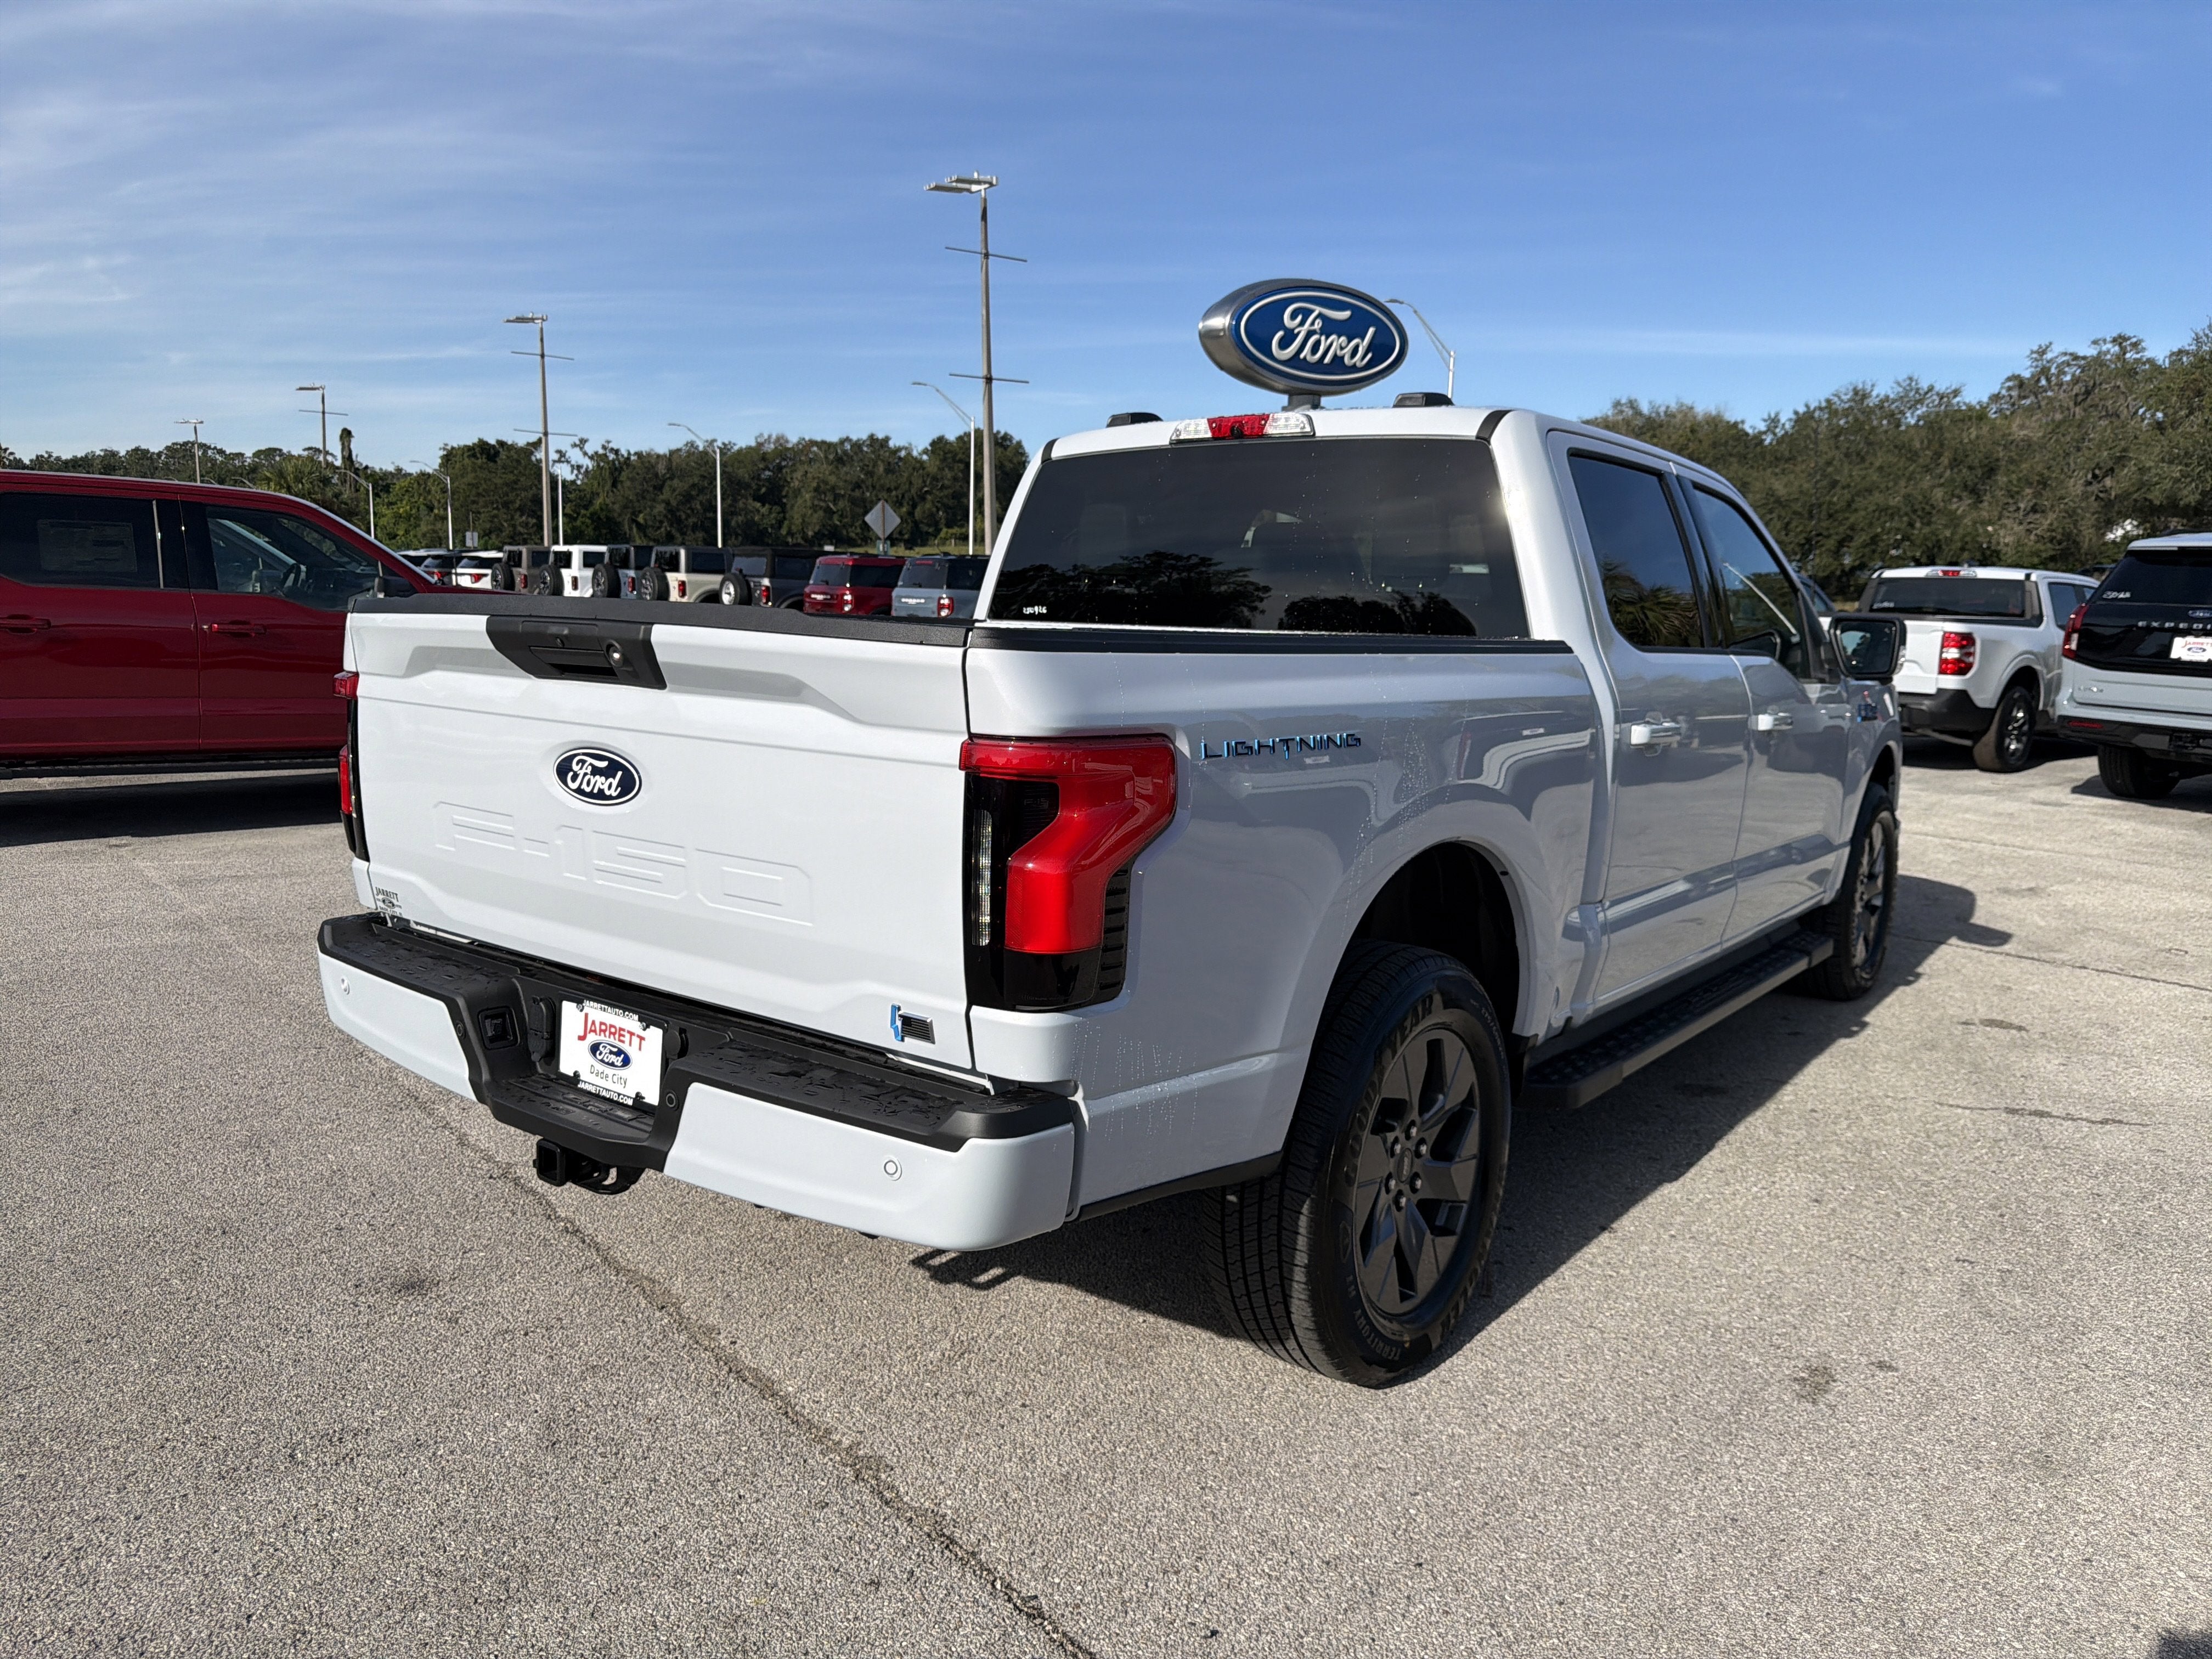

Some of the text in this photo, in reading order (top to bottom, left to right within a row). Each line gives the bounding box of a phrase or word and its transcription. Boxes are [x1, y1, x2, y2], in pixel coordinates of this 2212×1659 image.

[1272, 301, 1376, 368] Ford
[1200, 733, 1361, 760] LIGHTNING
[567, 755, 623, 797] Ford
[432, 801, 814, 927] F-150
[375, 887, 399, 902] JARRETT
[583, 999, 639, 1022] JARRETTAUTO.COM
[577, 1012, 646, 1051] JARRETT
[595, 1042, 624, 1067] Ford
[590, 1064, 628, 1088] Dade City
[578, 1081, 634, 1105] JARRETTAUTO.COM
